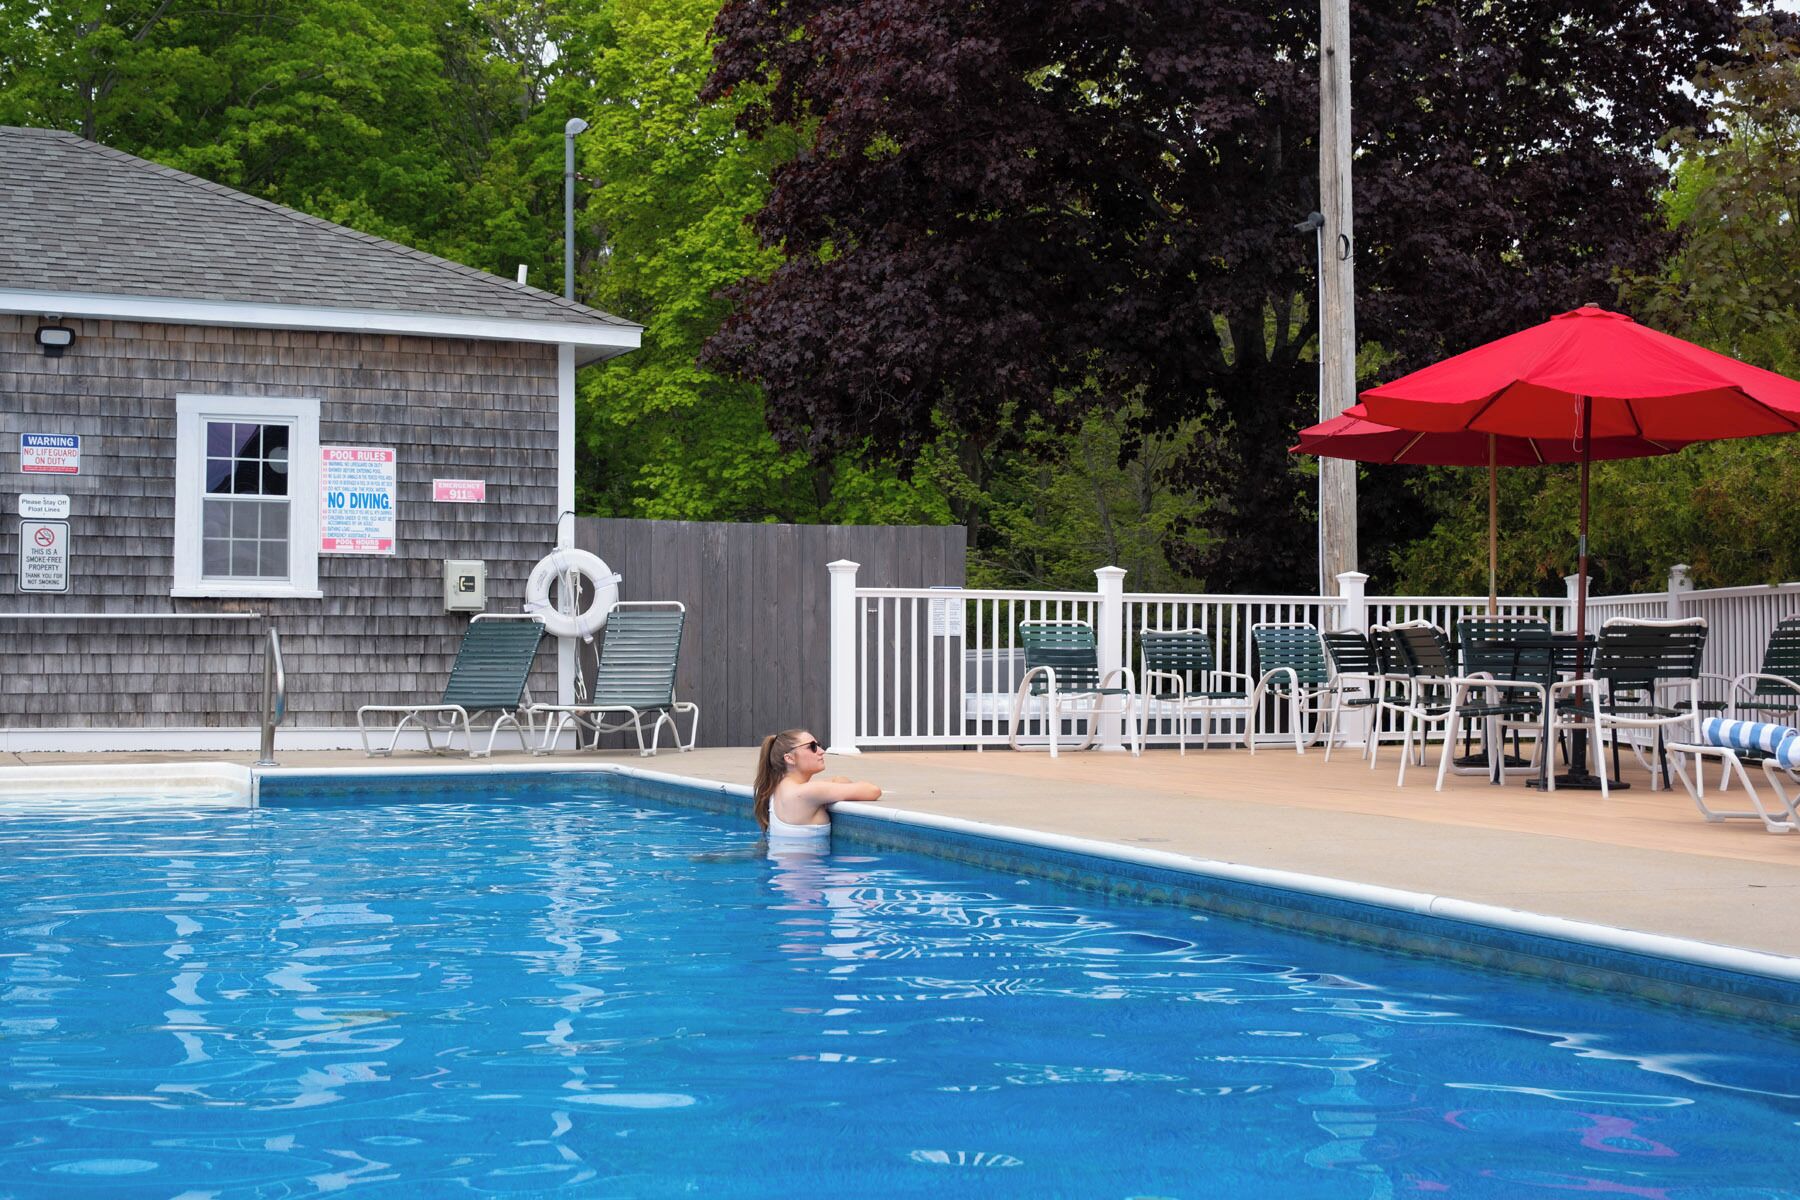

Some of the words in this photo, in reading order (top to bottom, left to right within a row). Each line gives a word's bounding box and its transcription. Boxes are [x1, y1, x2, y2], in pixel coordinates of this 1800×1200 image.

[28, 436, 74, 446] WARNING
[37, 449, 76, 457] LIFEGUARD
[330, 451, 354, 460] POOL
[358, 452, 386, 460] RULES
[450, 489, 467, 499] 911
[328, 492, 344, 508] NO
[350, 493, 392, 509] DIVING.
